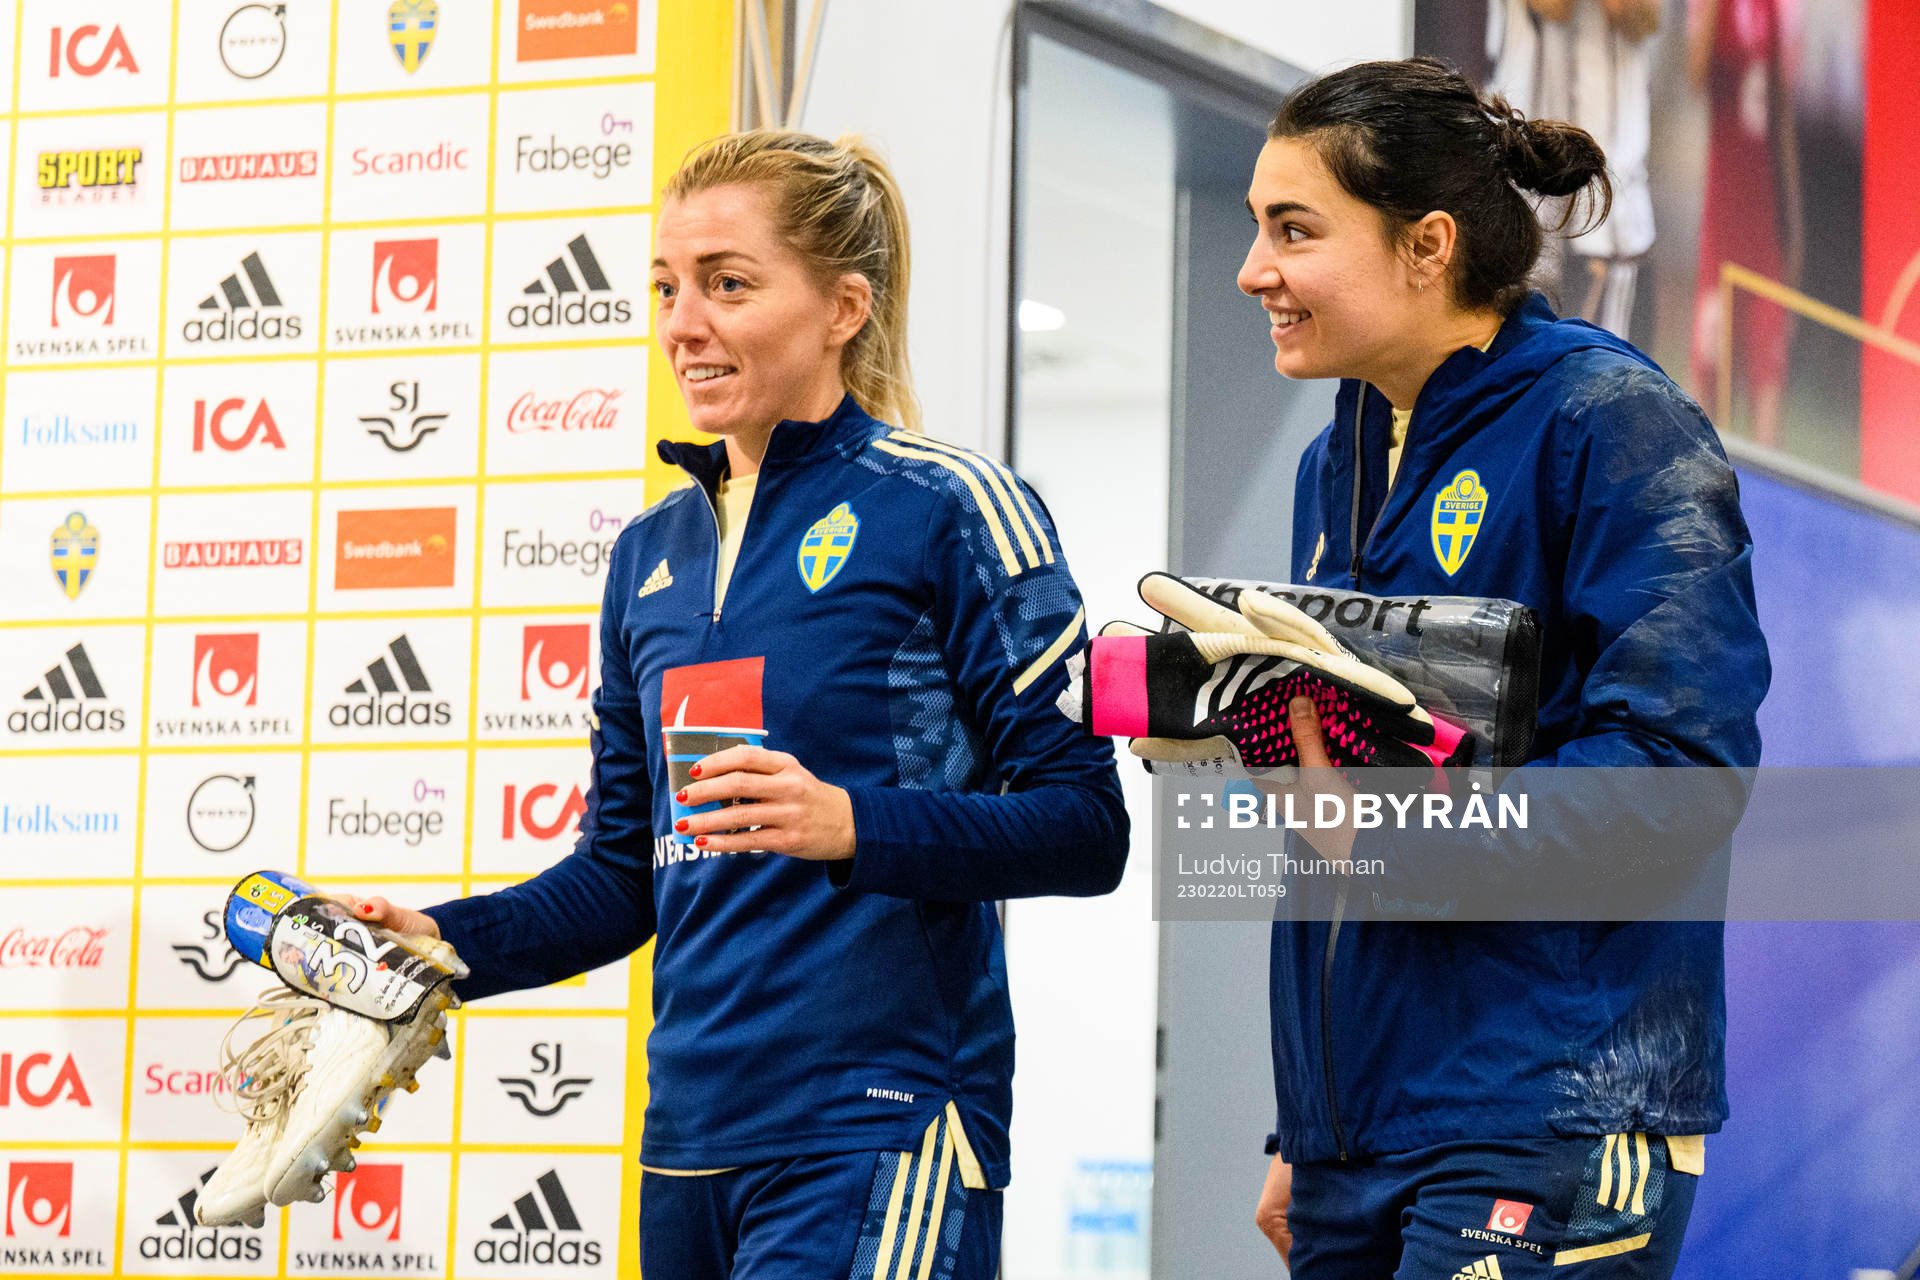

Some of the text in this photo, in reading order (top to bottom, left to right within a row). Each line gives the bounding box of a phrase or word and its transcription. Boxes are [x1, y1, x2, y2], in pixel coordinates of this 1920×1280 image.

[525, 10, 605, 31] Swedbank
[49, 24, 140, 78] ICA
[38, 149, 142, 188] SPORT
[180, 152, 316, 182] BAUHAUS
[353, 143, 469, 176] Scandic
[516, 135, 632, 179] Fabege
[507, 292, 632, 328] adidas
[183, 309, 302, 344] adidas
[335, 322, 474, 343] SVENSKA SPEL
[15, 338, 150, 357] SVENSKA SPEL
[389, 381, 420, 412] SJ
[22, 416, 137, 446] Folksam
[193, 398, 286, 452] ICA
[1445, 501, 1479, 511] SVERIGE
[164, 541, 302, 568] BAUHAUS
[344, 541, 422, 560] Swedbank
[8, 702, 126, 734] adidas
[156, 719, 293, 736] SVENSKA SPEL
[328, 696, 452, 728] adidas
[484, 713, 573, 730] SVENSKA
[328, 798, 444, 845] Fabege
[308, 920, 399, 995] 32
[530, 1042, 563, 1076] SJ
[0, 1053, 92, 1108] ICA
[866, 1087, 915, 1104] PRIMEBLUE
[139, 1228, 263, 1261] adidas
[473, 1232, 602, 1268] adidas
[1460, 1227, 1544, 1255] SVENSKA SPEL
[62, 1249, 106, 1267] SPEL
[295, 1253, 438, 1271] SVENSKA SPEL
